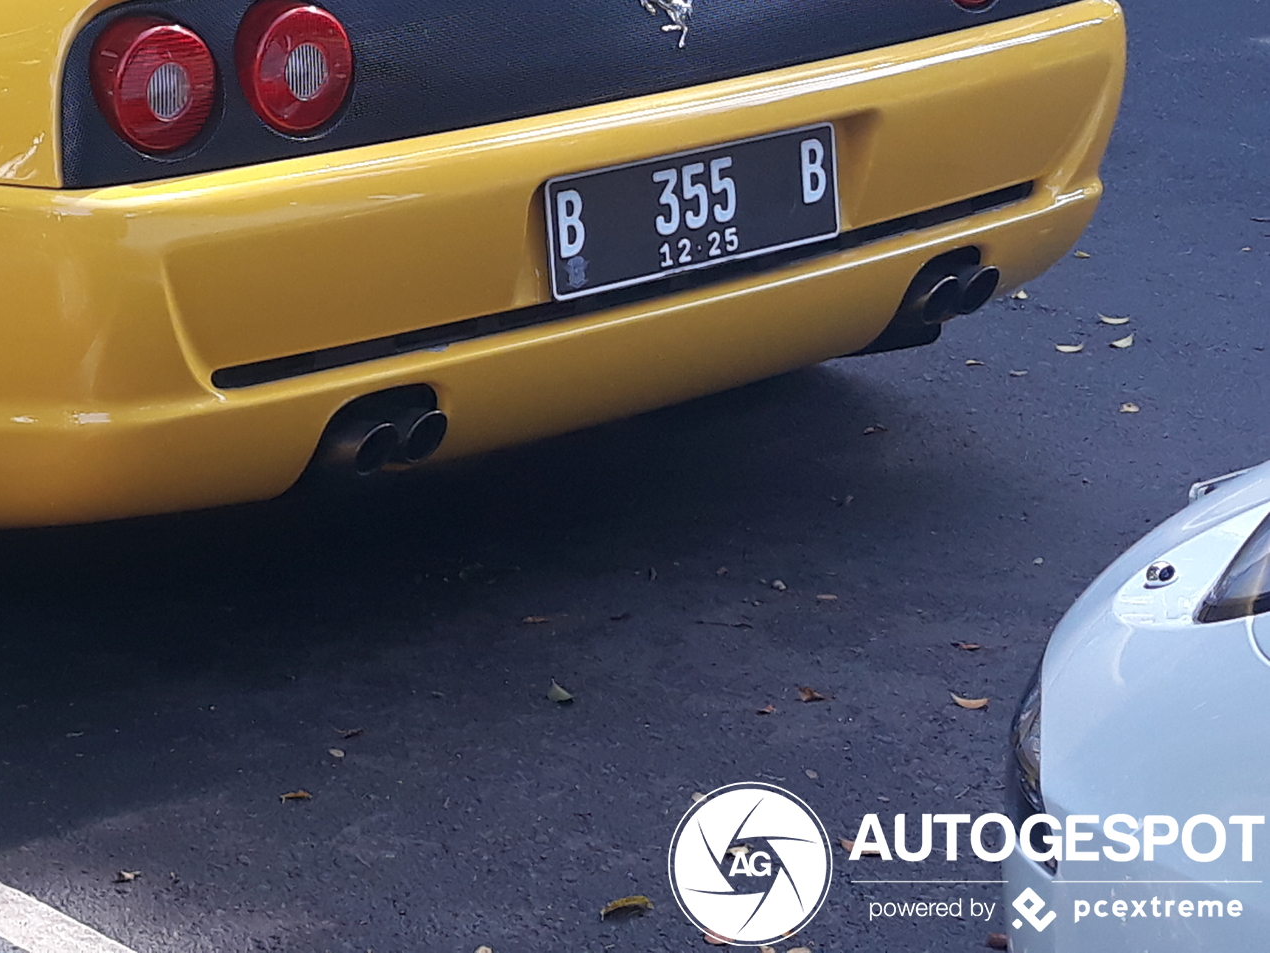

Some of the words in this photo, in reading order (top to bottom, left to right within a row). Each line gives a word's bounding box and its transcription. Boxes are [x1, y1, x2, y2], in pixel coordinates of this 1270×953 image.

[556, 189, 586, 259] B
[652, 156, 737, 236] 355
[800, 138, 827, 204] B
